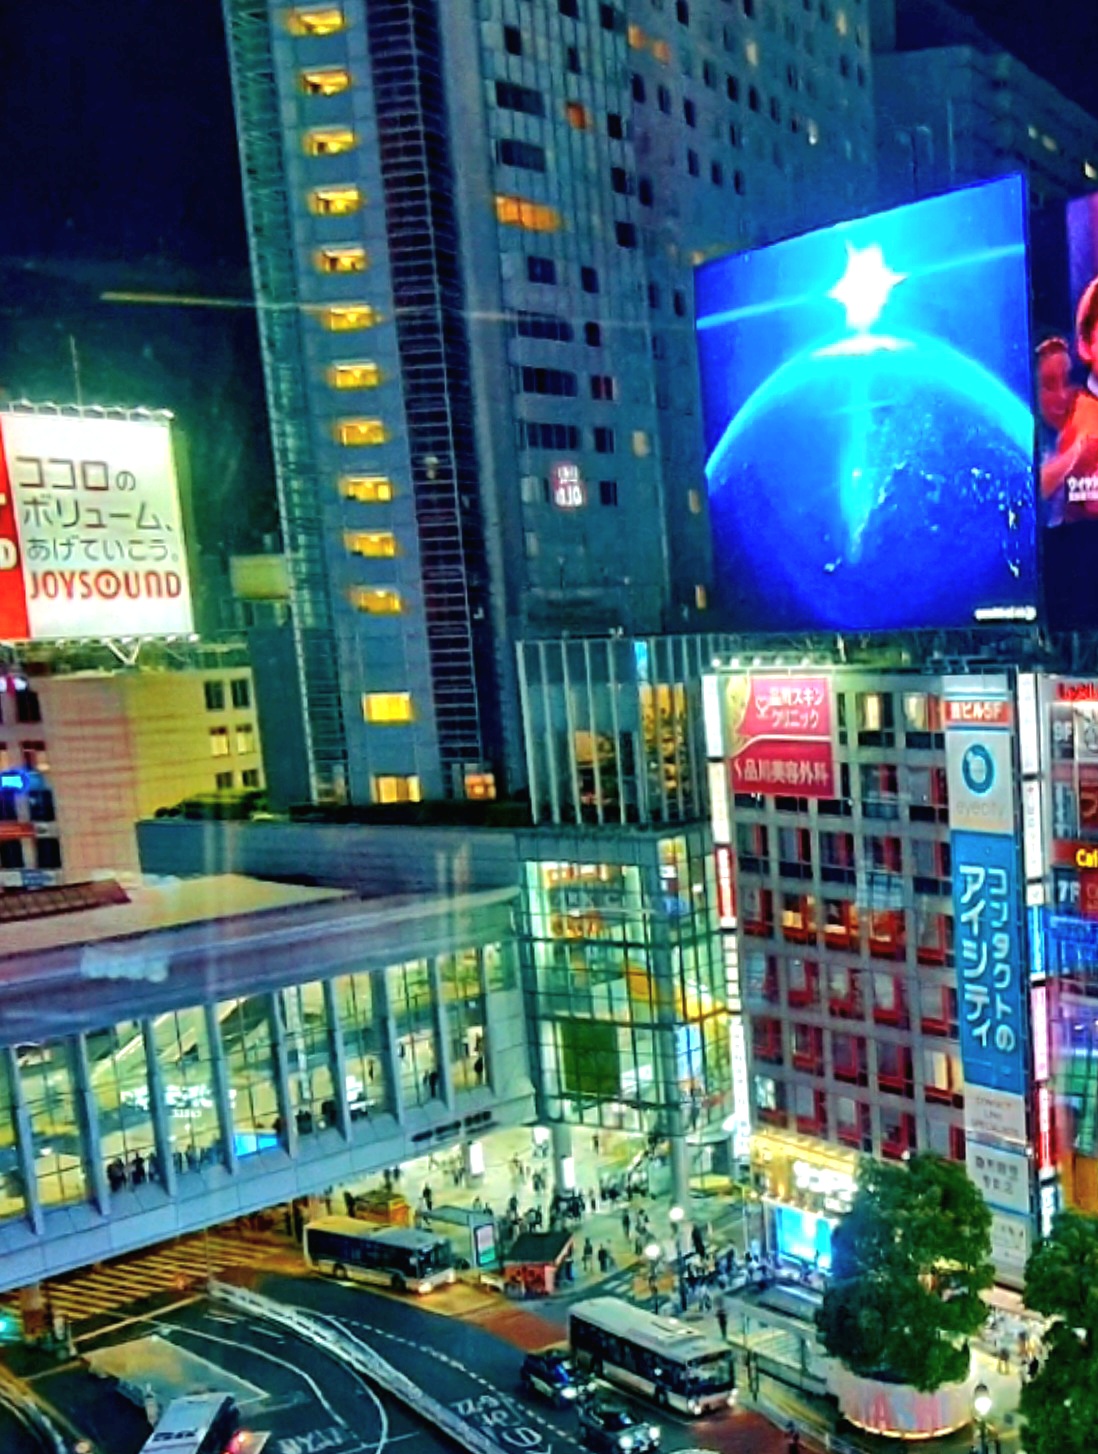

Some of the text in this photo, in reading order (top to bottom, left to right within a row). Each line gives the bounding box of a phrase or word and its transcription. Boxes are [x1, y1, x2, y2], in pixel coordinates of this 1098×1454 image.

[16, 456, 136, 491] ココロの
[30, 570, 182, 599] JOYSOUND
[959, 864, 992, 1047] アイシティ
[987, 867, 1016, 1052] コンタクトの
